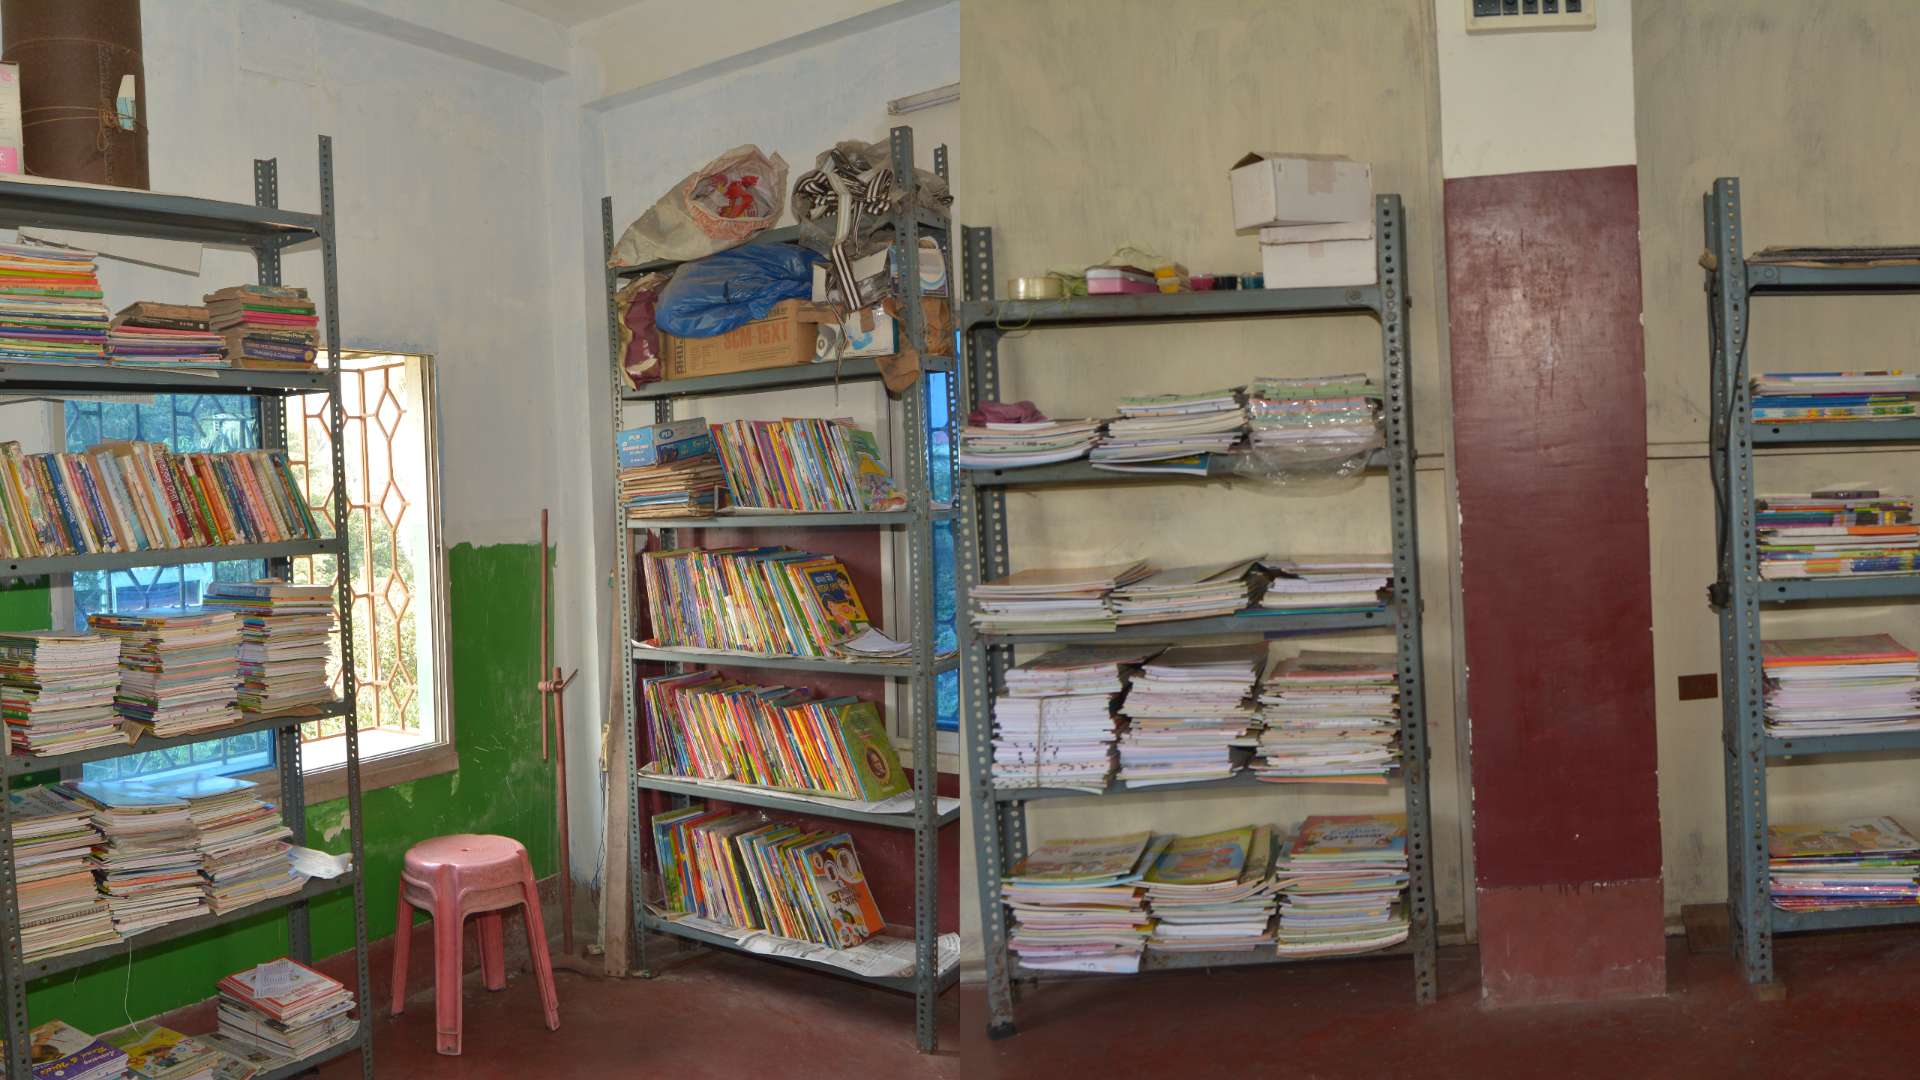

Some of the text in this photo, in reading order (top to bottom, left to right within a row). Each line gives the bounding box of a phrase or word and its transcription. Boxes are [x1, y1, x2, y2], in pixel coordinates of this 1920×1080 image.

[724, 321, 789, 350] SCM-15XT
[676, 336, 685, 374] AHUJ
[1322, 833, 1385, 841] Grammar
[83, 1050, 115, 1065] Learning
